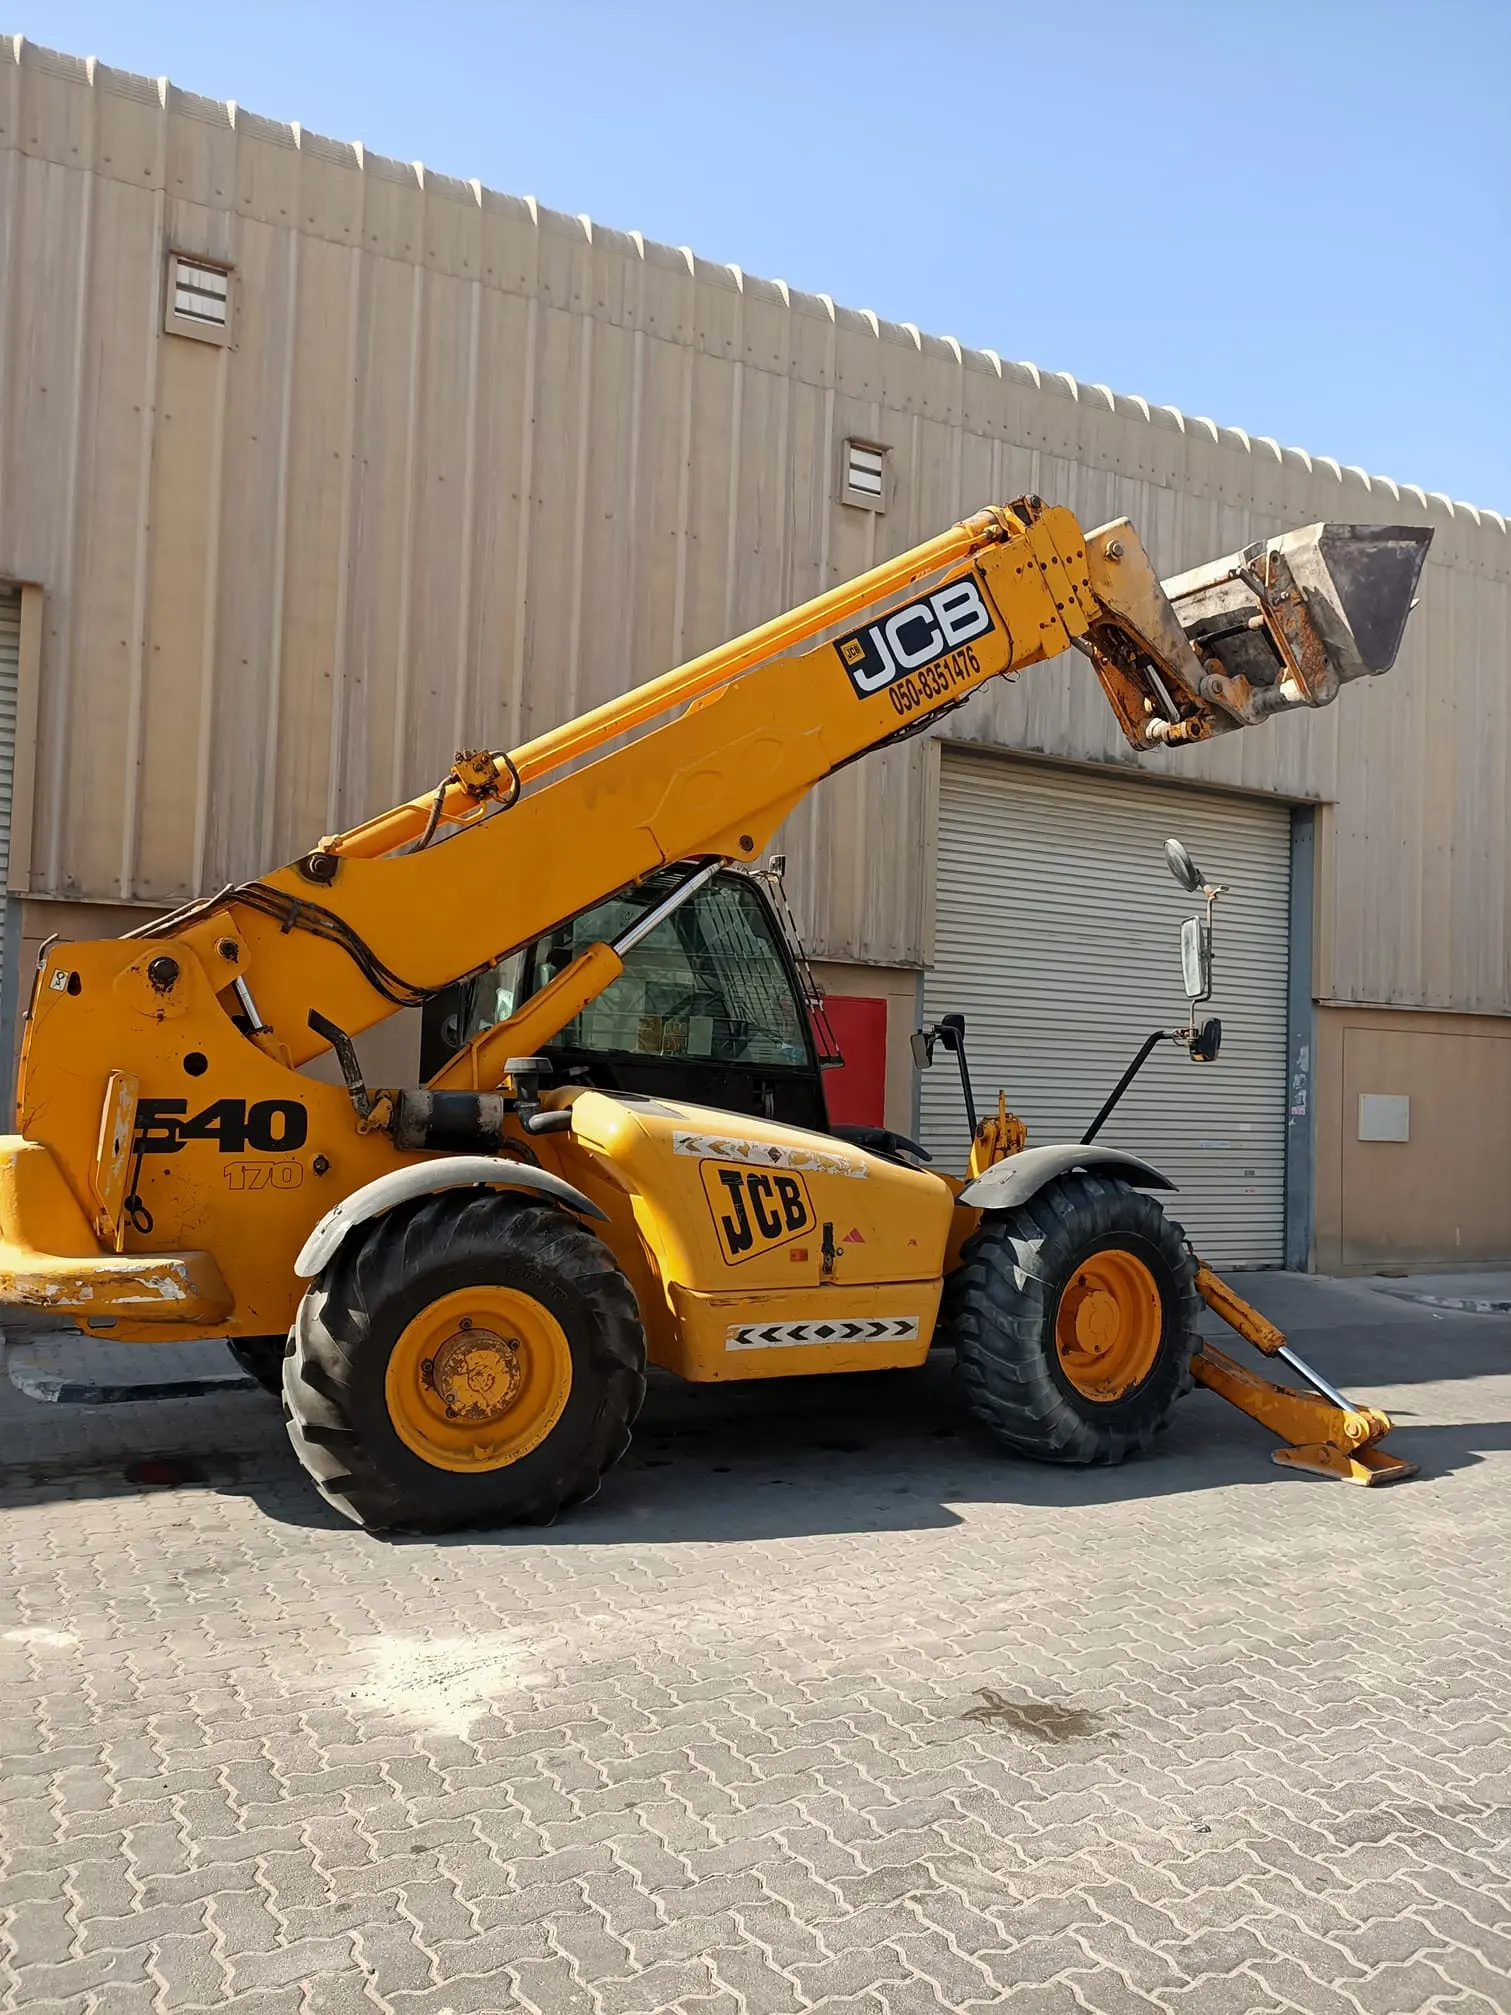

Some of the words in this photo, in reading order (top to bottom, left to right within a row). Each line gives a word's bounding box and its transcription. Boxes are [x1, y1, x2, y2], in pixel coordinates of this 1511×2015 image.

[845, 645, 861, 660] JCB
[853, 581, 989, 692] JCB
[889, 645, 980, 715] 050-8351476
[132, 1098, 308, 1153] 540
[224, 1160, 304, 1190] 170
[718, 1169, 807, 1255] JCB
